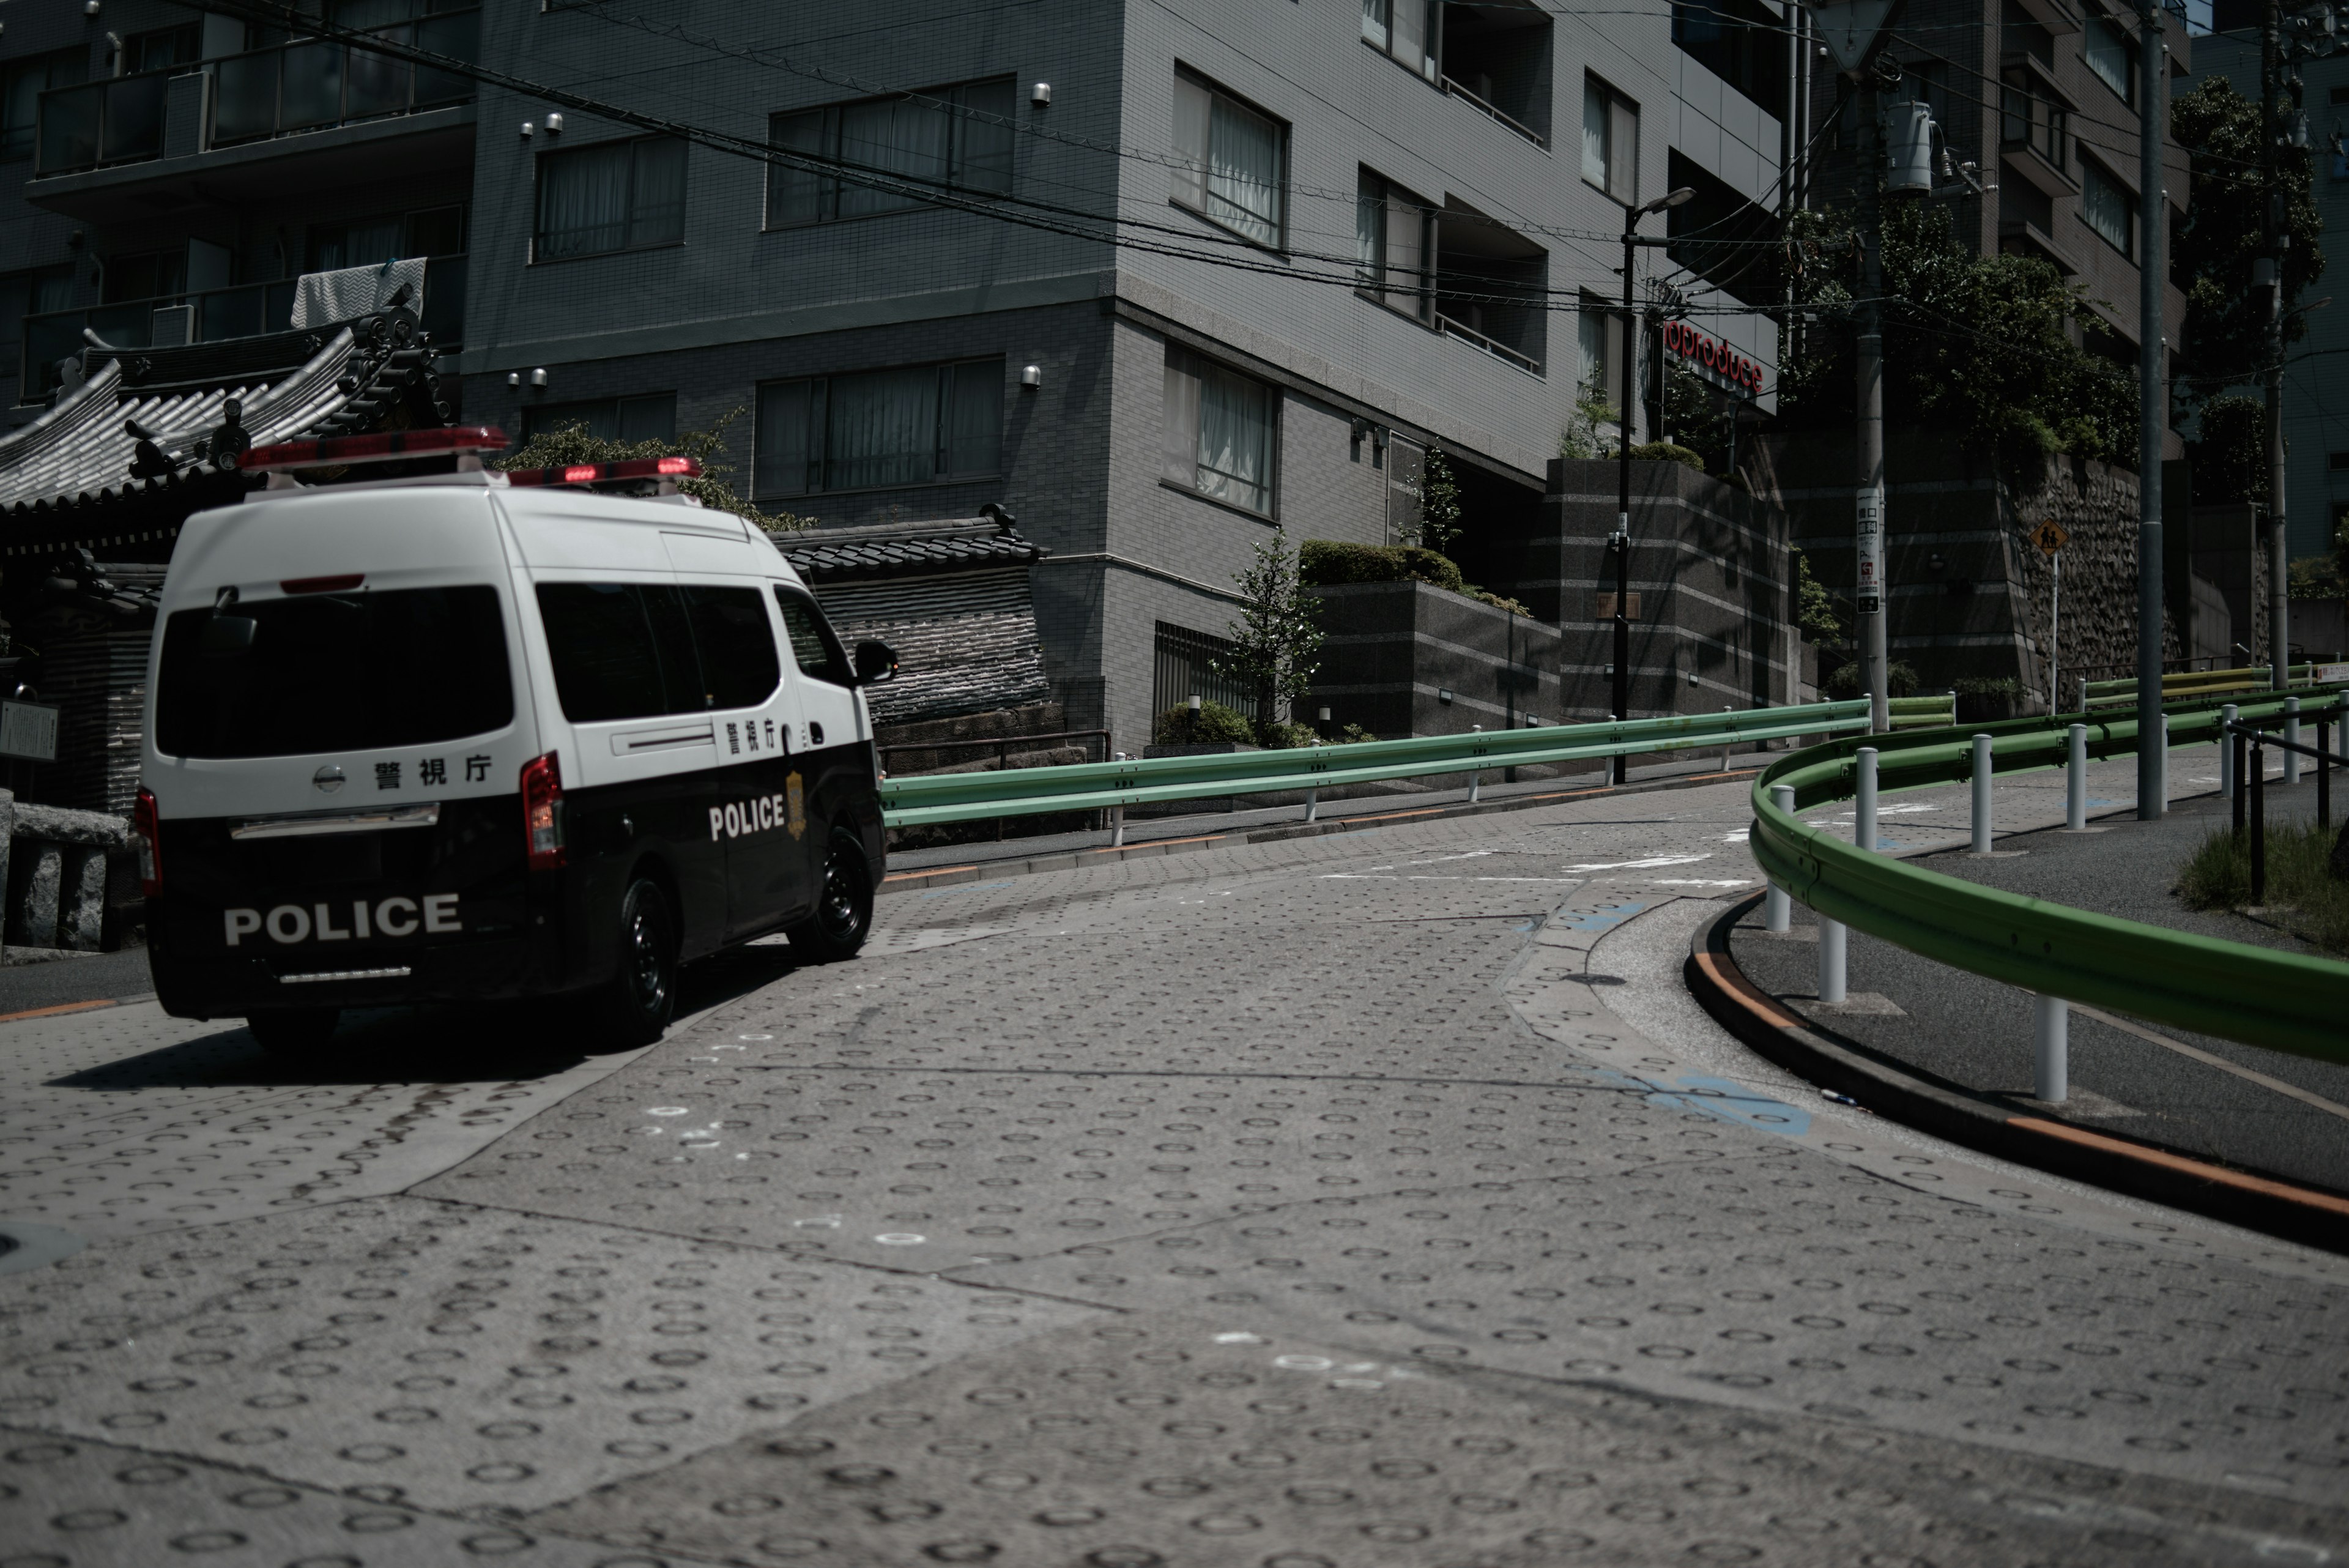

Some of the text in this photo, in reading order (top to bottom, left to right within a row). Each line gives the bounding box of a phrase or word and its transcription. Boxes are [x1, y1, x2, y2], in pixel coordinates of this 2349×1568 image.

[726, 718, 774, 754] 警視庁
[374, 754, 492, 790] 警視庁
[708, 793, 785, 842] POLICE
[223, 893, 463, 947] POLICE
